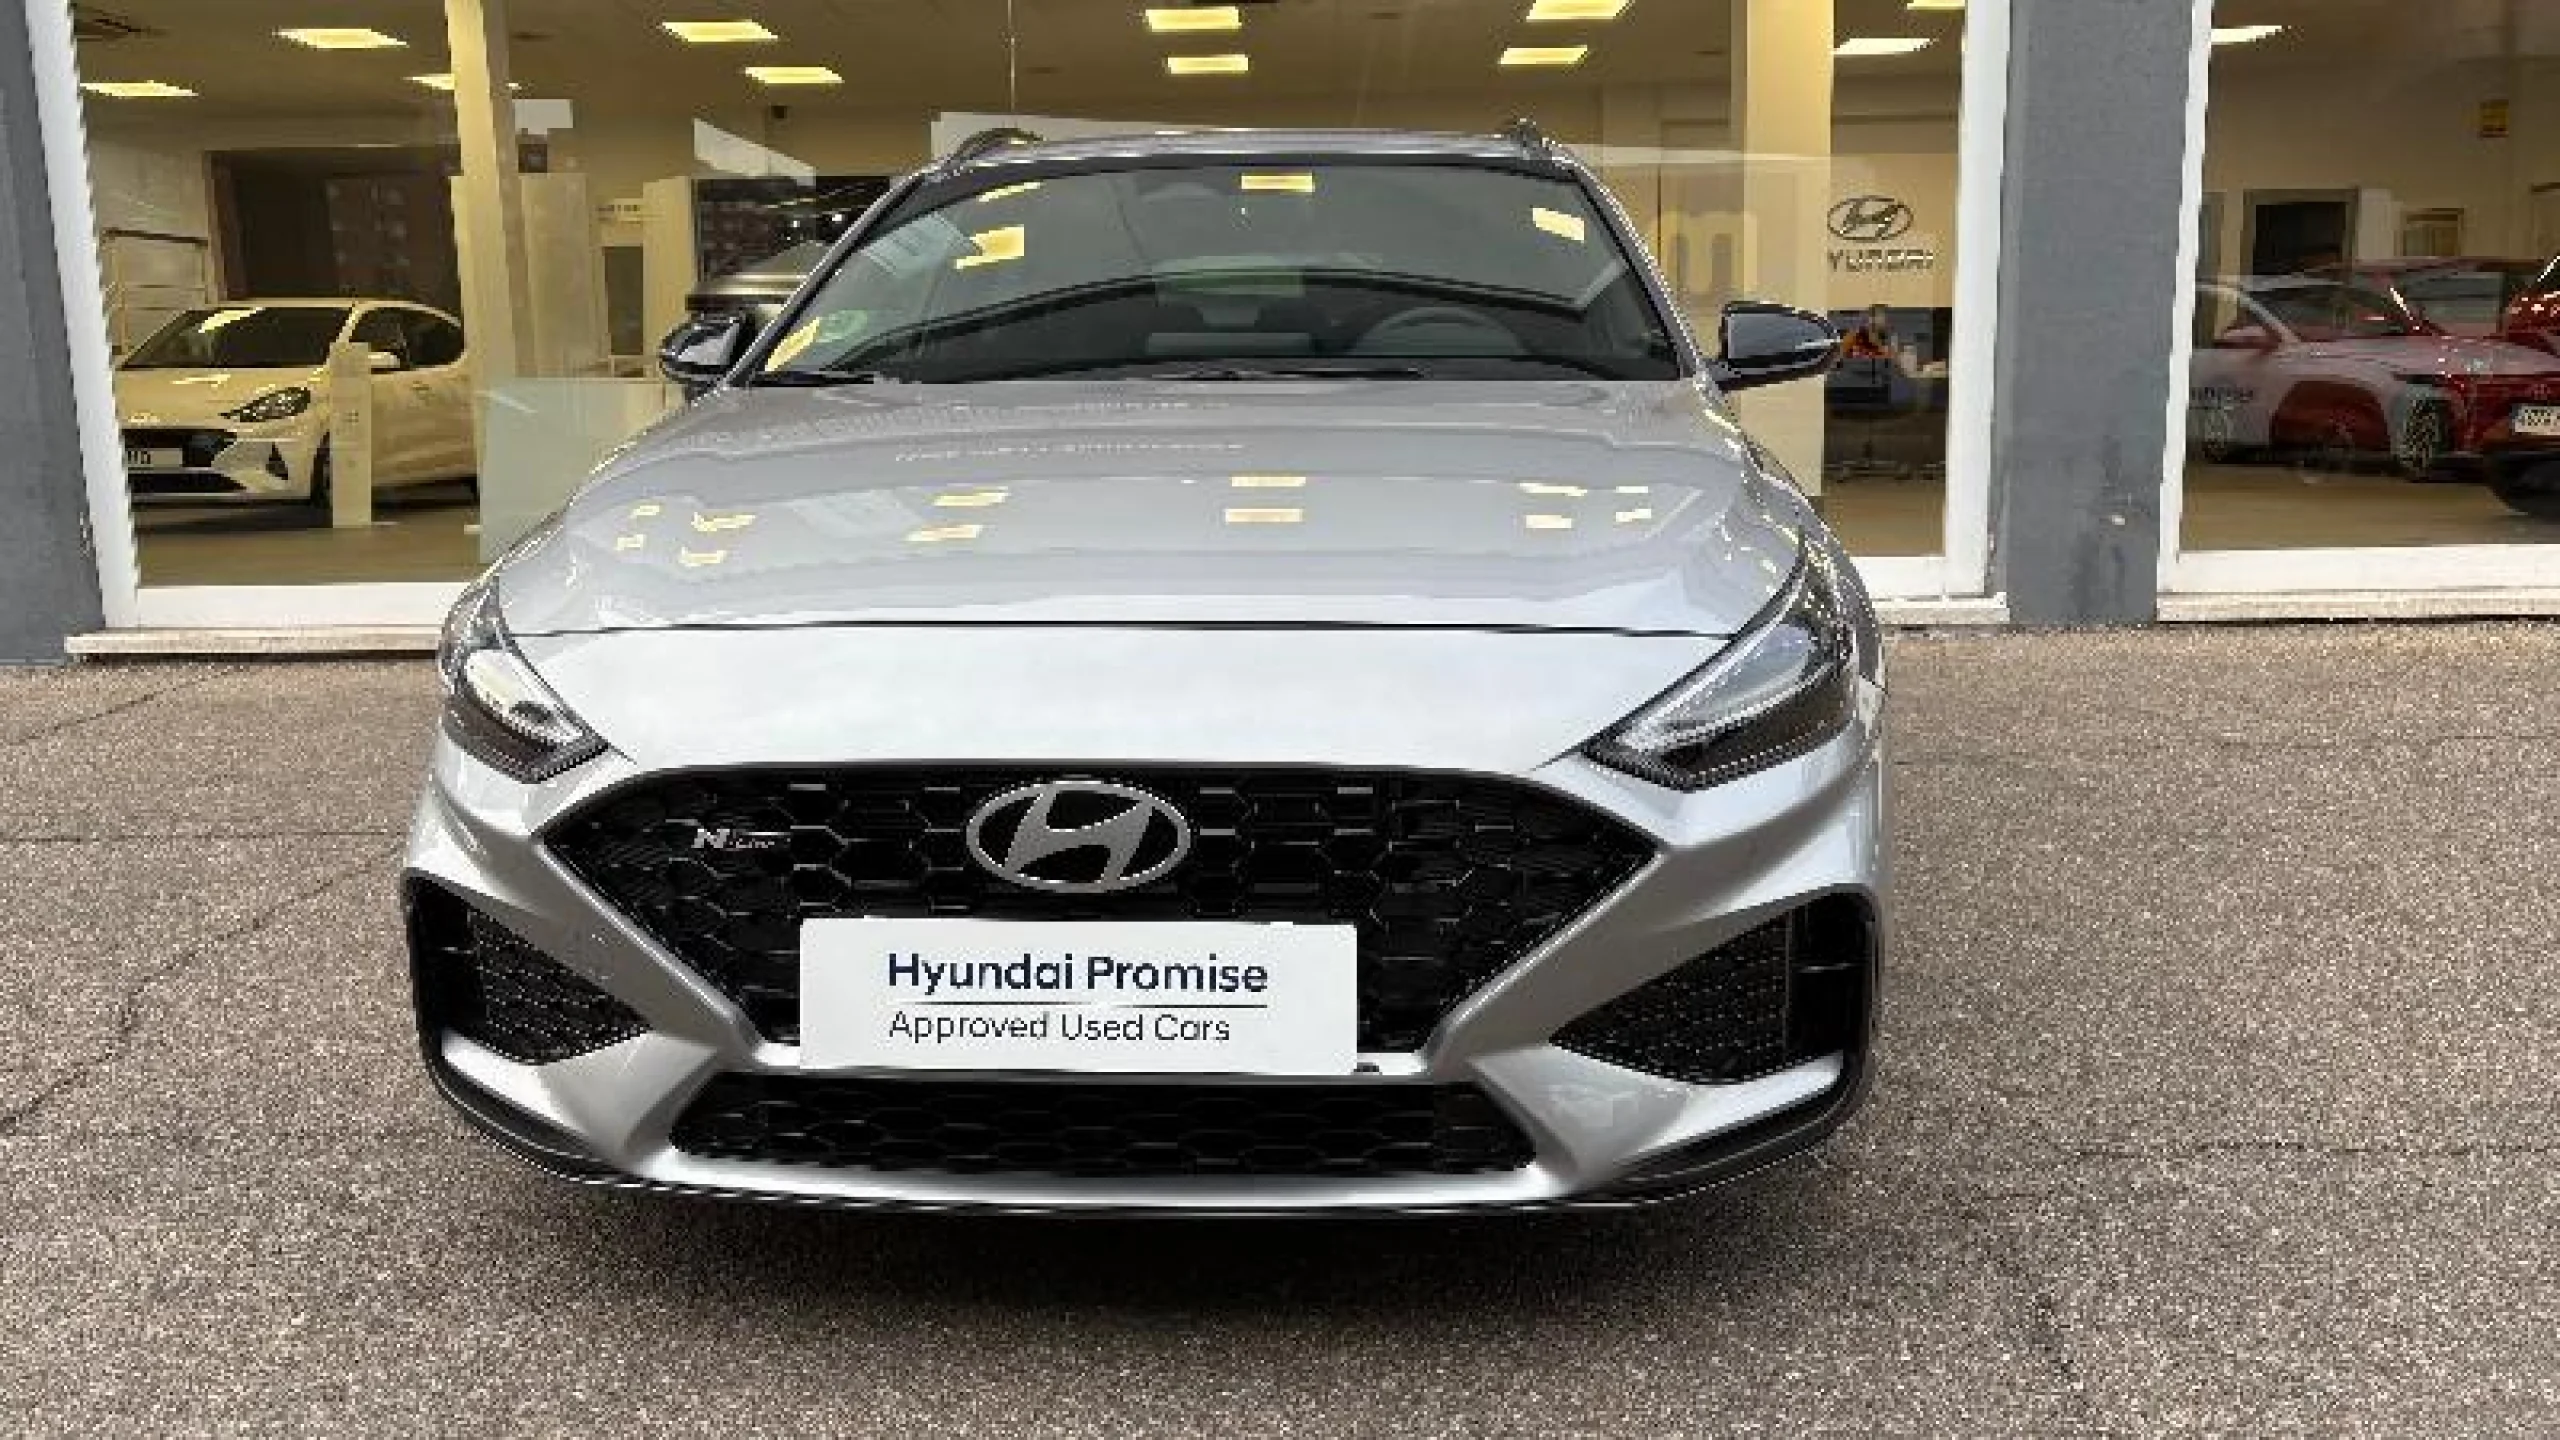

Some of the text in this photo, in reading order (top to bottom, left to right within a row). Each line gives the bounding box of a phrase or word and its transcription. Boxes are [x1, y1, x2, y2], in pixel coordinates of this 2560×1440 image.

[1827, 249, 1933, 272] YUNDAI
[889, 953, 1268, 995] Hyundai Promise
[889, 1010, 1230, 1043] Approved Used Cars
